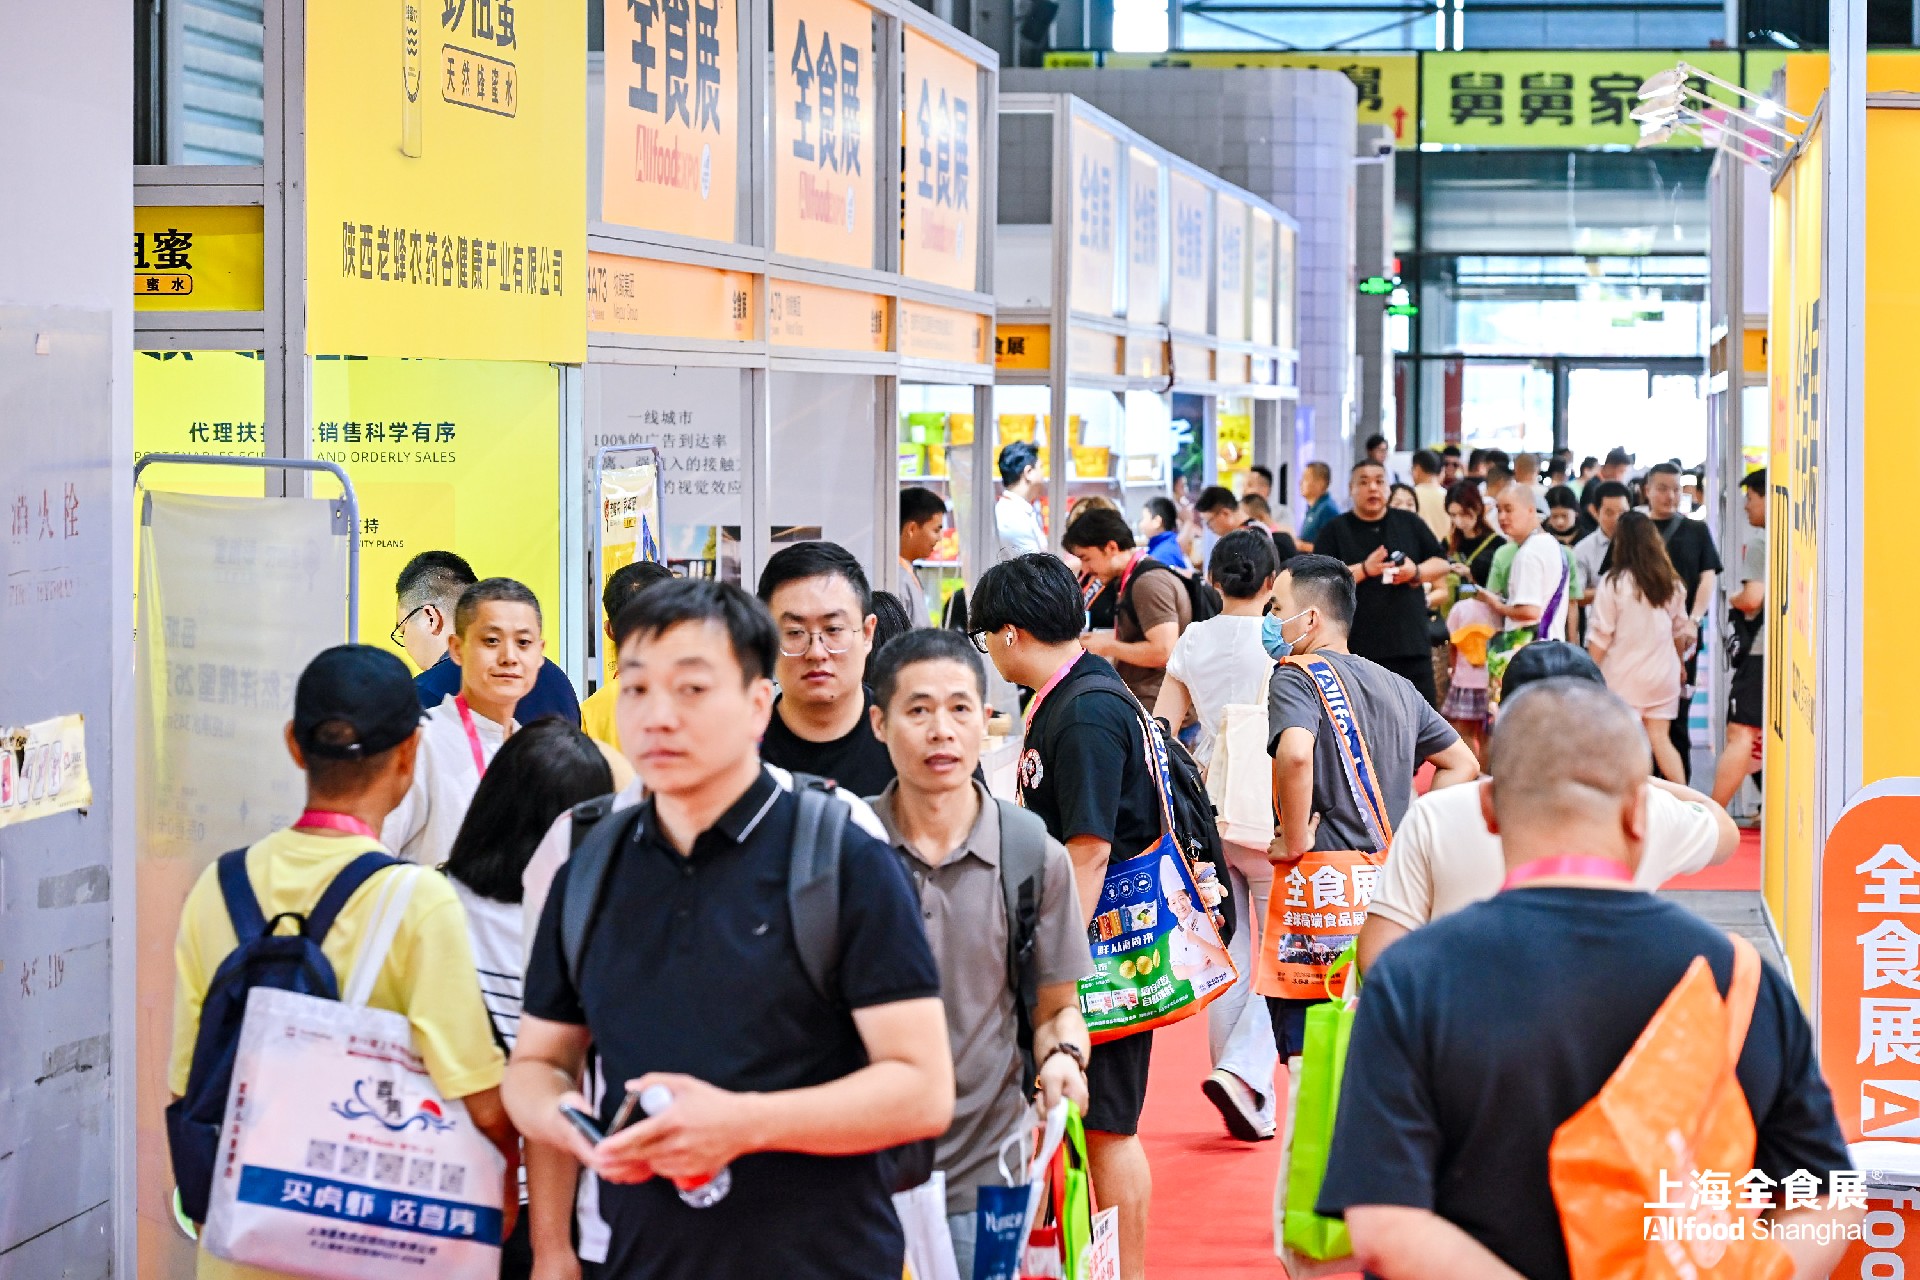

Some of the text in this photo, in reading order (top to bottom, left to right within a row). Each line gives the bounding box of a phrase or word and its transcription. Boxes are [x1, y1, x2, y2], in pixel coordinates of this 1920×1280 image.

[446, 57, 513, 107] 天然蜂蜜水
[791, 18, 861, 177] 全食展
[917, 77, 969, 212] 全食展
[342, 221, 563, 297] 陕西老蜂农药谷健康产业有限公司
[351, 451, 411, 463] ORDERLY
[416, 451, 457, 463] SALES
[376, 540, 404, 548] PLANS
[1856, 844, 1920, 1068] 全食展
